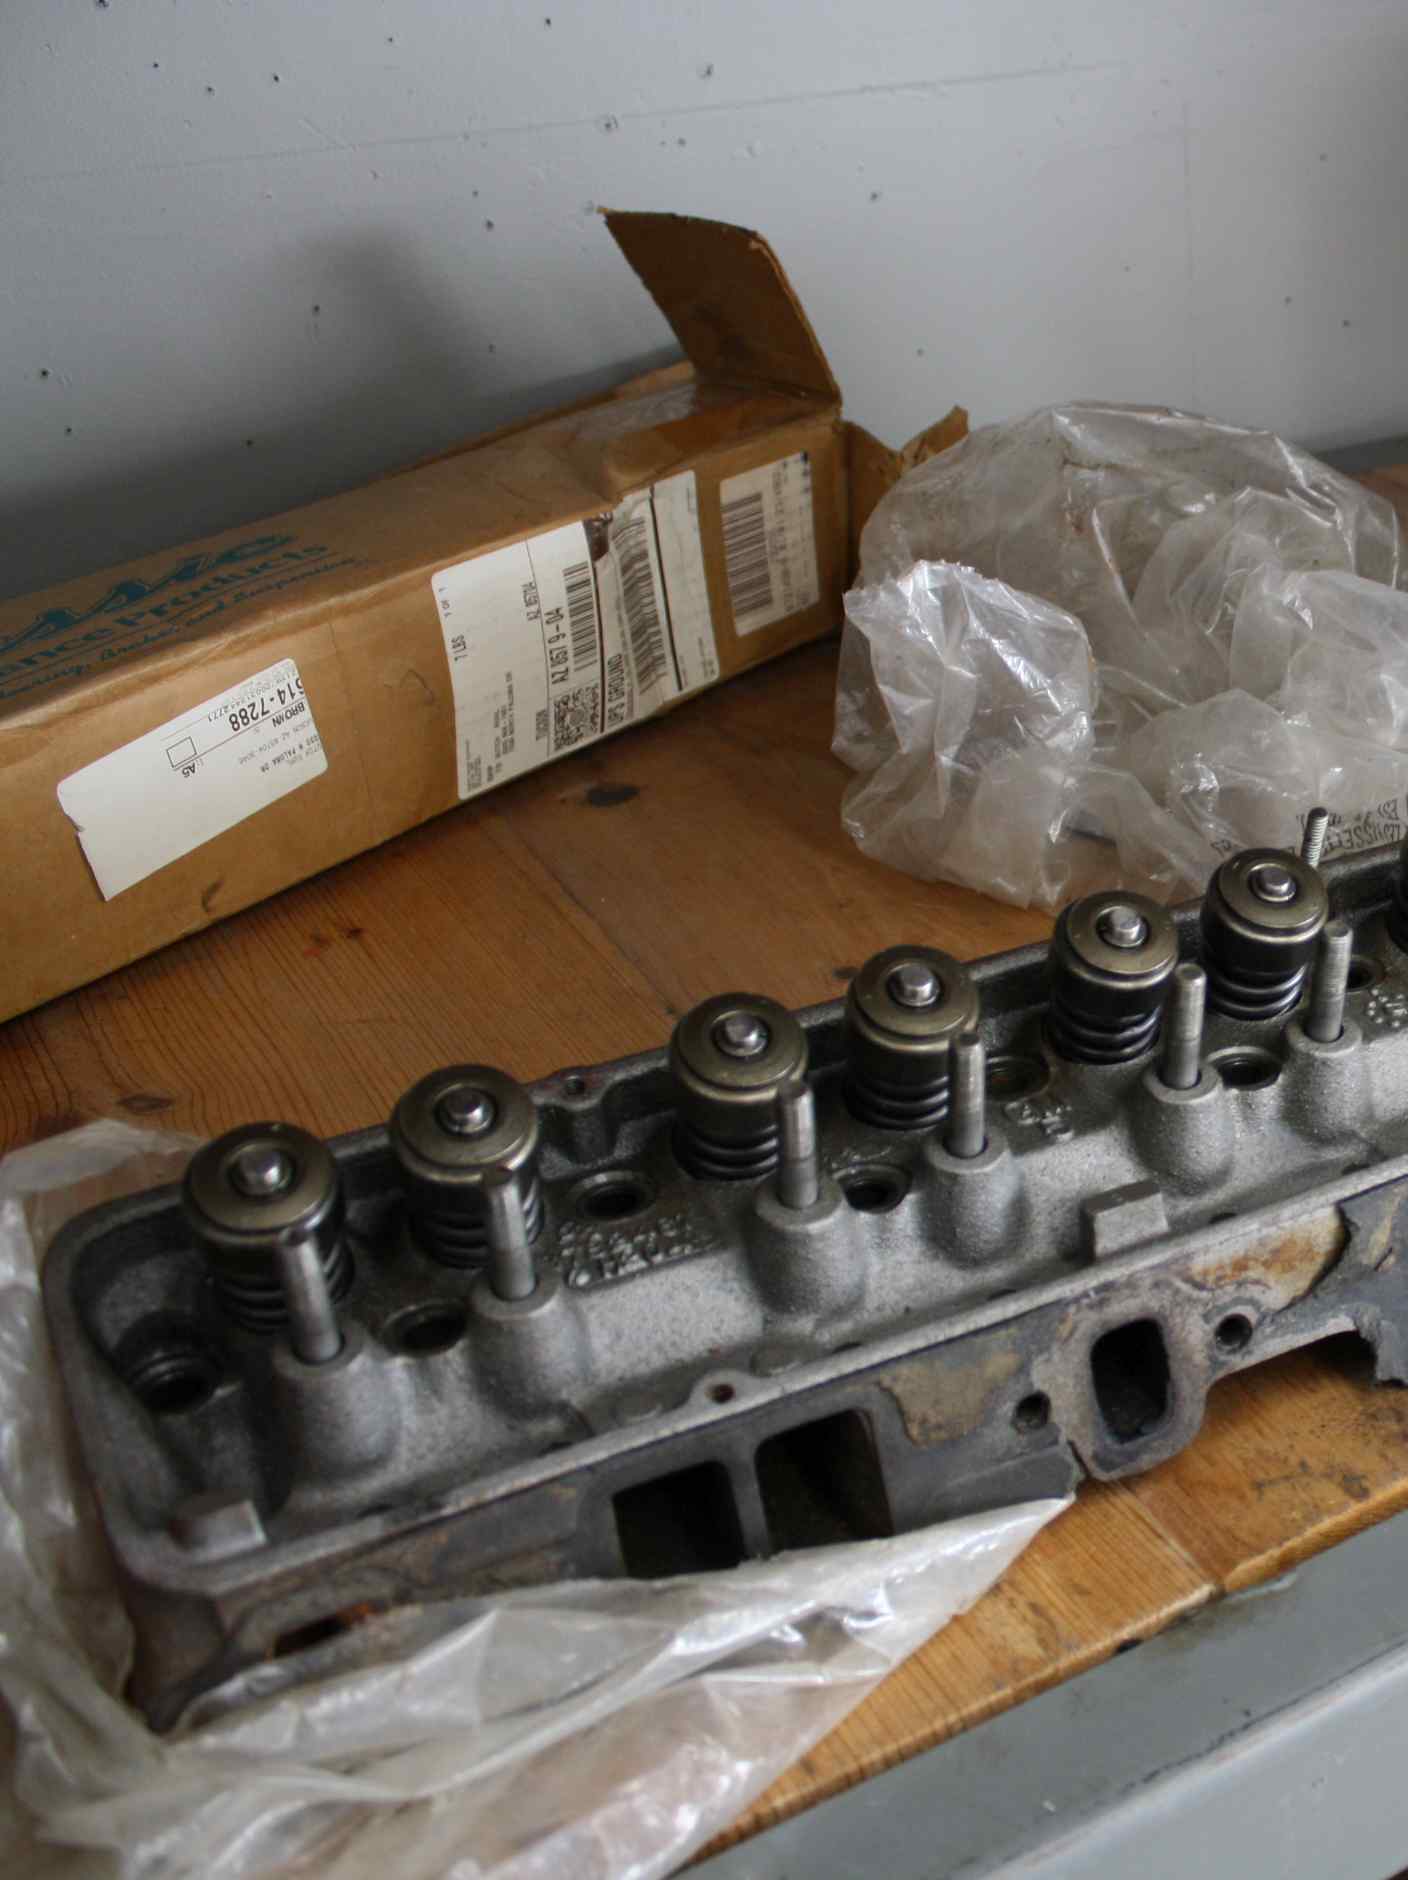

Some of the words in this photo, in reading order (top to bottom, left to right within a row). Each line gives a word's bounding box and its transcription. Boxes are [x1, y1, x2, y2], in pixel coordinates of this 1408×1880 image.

[110, 546, 329, 628] Products
[451, 634, 466, 652] LBS
[551, 667, 569, 685] AZ
[608, 654, 625, 702] GROUND
[608, 703, 624, 725] UPS
